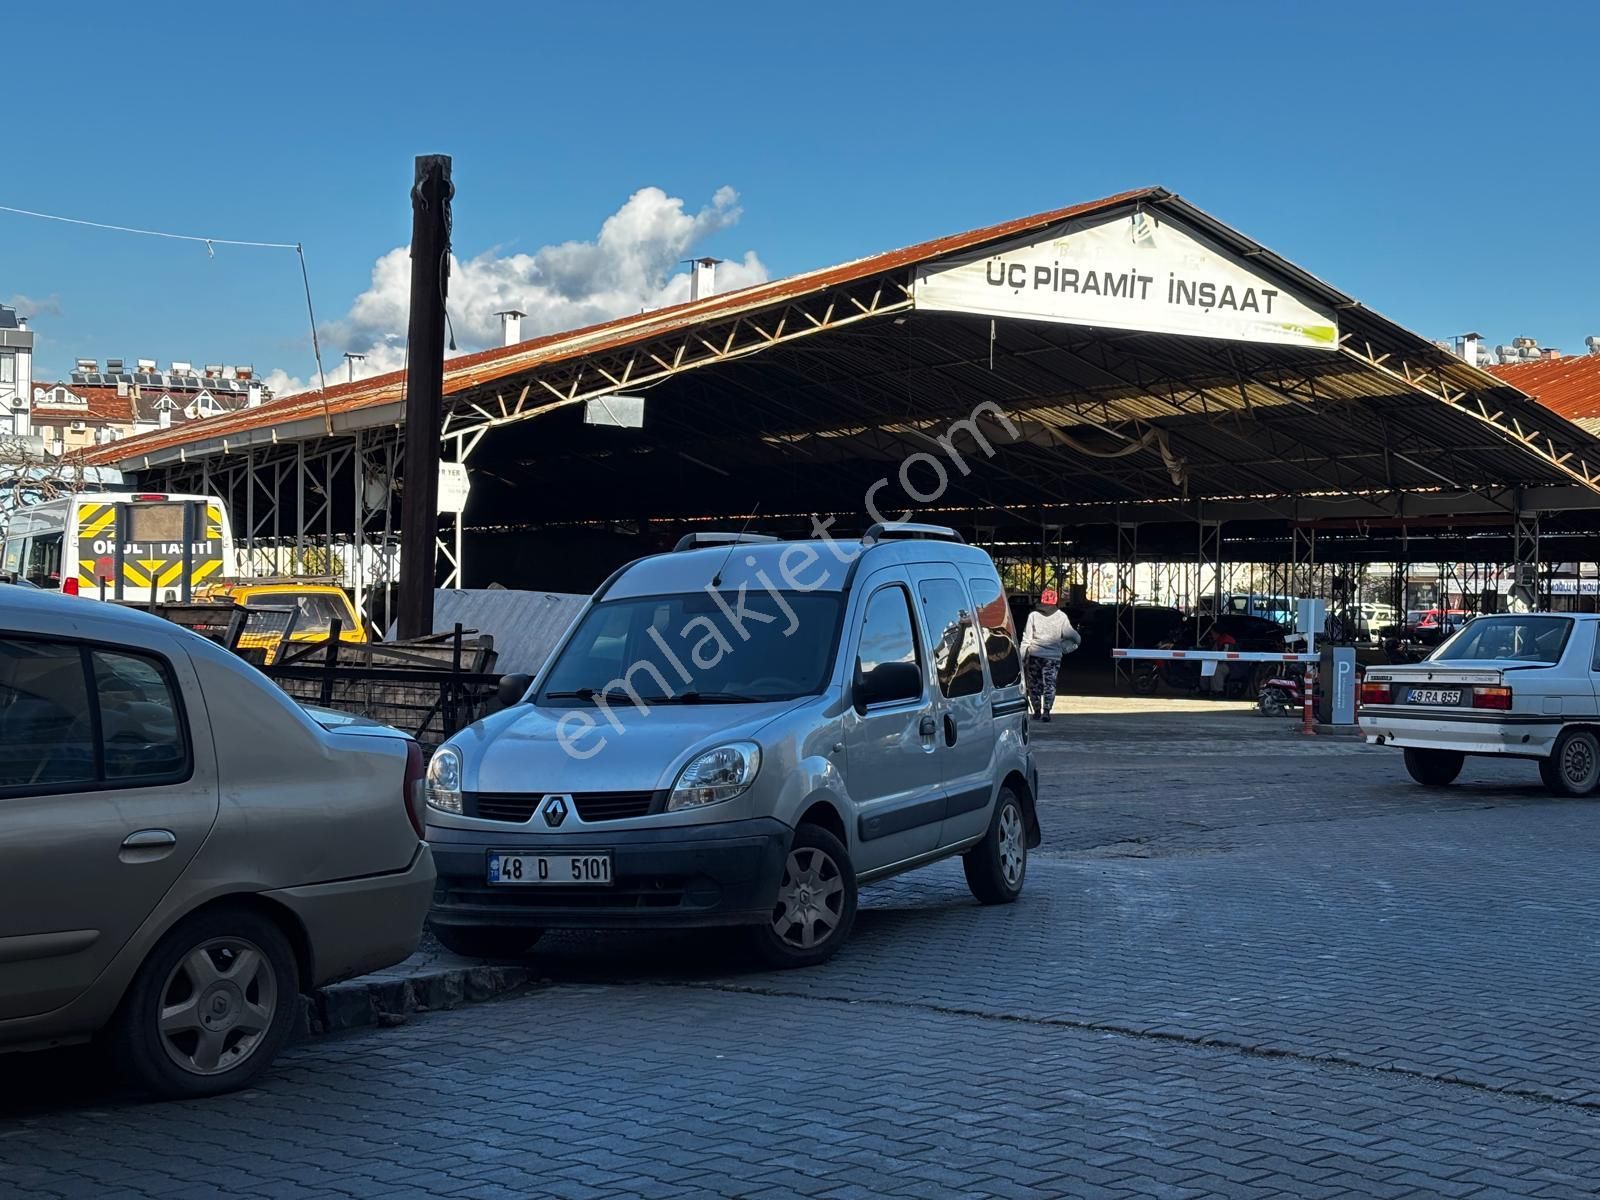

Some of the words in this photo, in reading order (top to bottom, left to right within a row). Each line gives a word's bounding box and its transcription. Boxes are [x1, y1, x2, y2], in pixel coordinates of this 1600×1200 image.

[986, 256, 1026, 295] ÜÇ
[1034, 261, 1154, 300] PİRAMİT
[1168, 272, 1278, 314] İNŞAAT
[1424, 691, 1438, 703] RA
[1441, 692, 1459, 704] 855
[502, 858, 522, 879] 48
[538, 859, 548, 880] D
[571, 858, 608, 880] 5101
